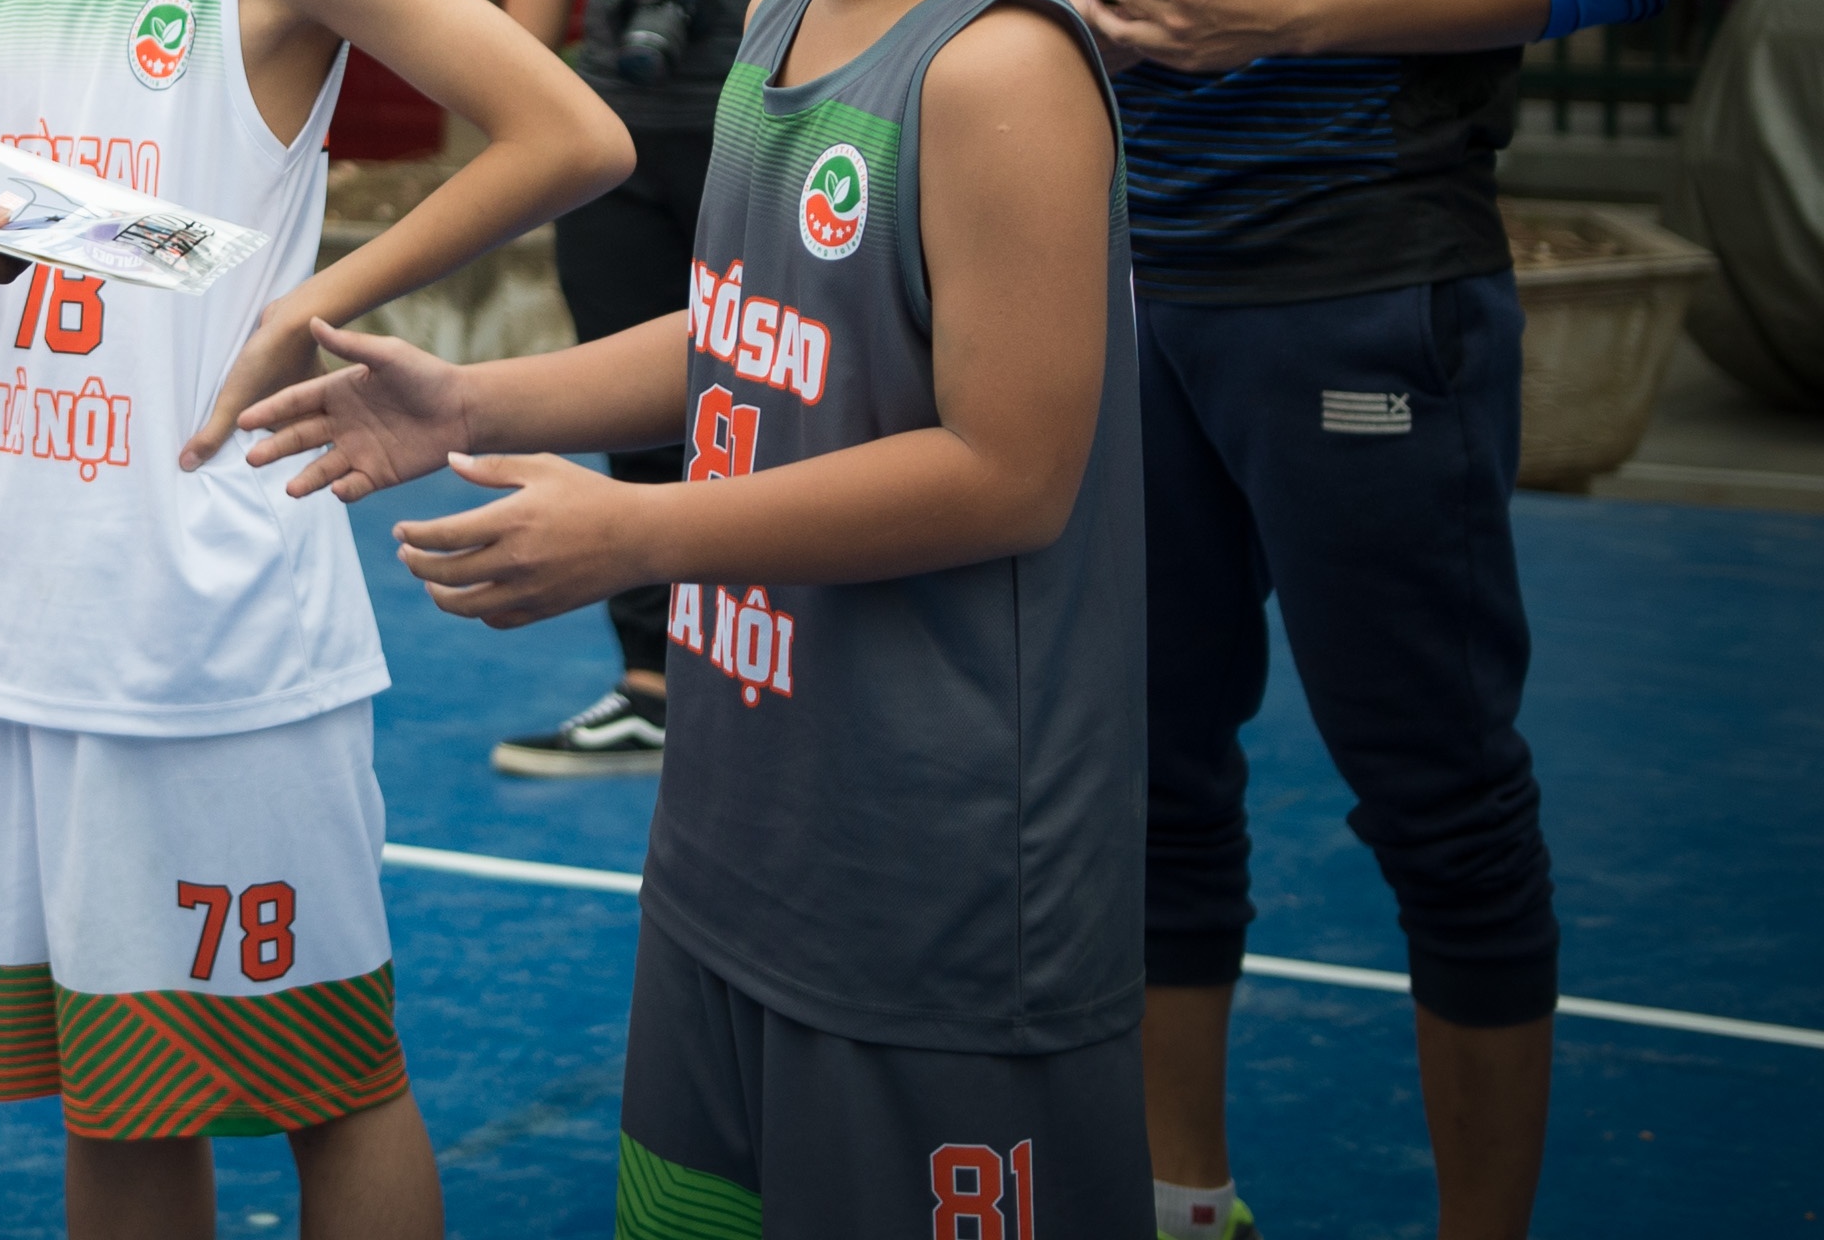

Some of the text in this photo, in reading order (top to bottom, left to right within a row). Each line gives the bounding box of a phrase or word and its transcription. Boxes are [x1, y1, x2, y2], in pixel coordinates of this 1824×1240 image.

[32, 376, 132, 482] NỘI
[687, 383, 762, 484] 81
[711, 585, 795, 708] NỘI
[177, 879, 296, 983] 78
[930, 1138, 1035, 1240] 81
